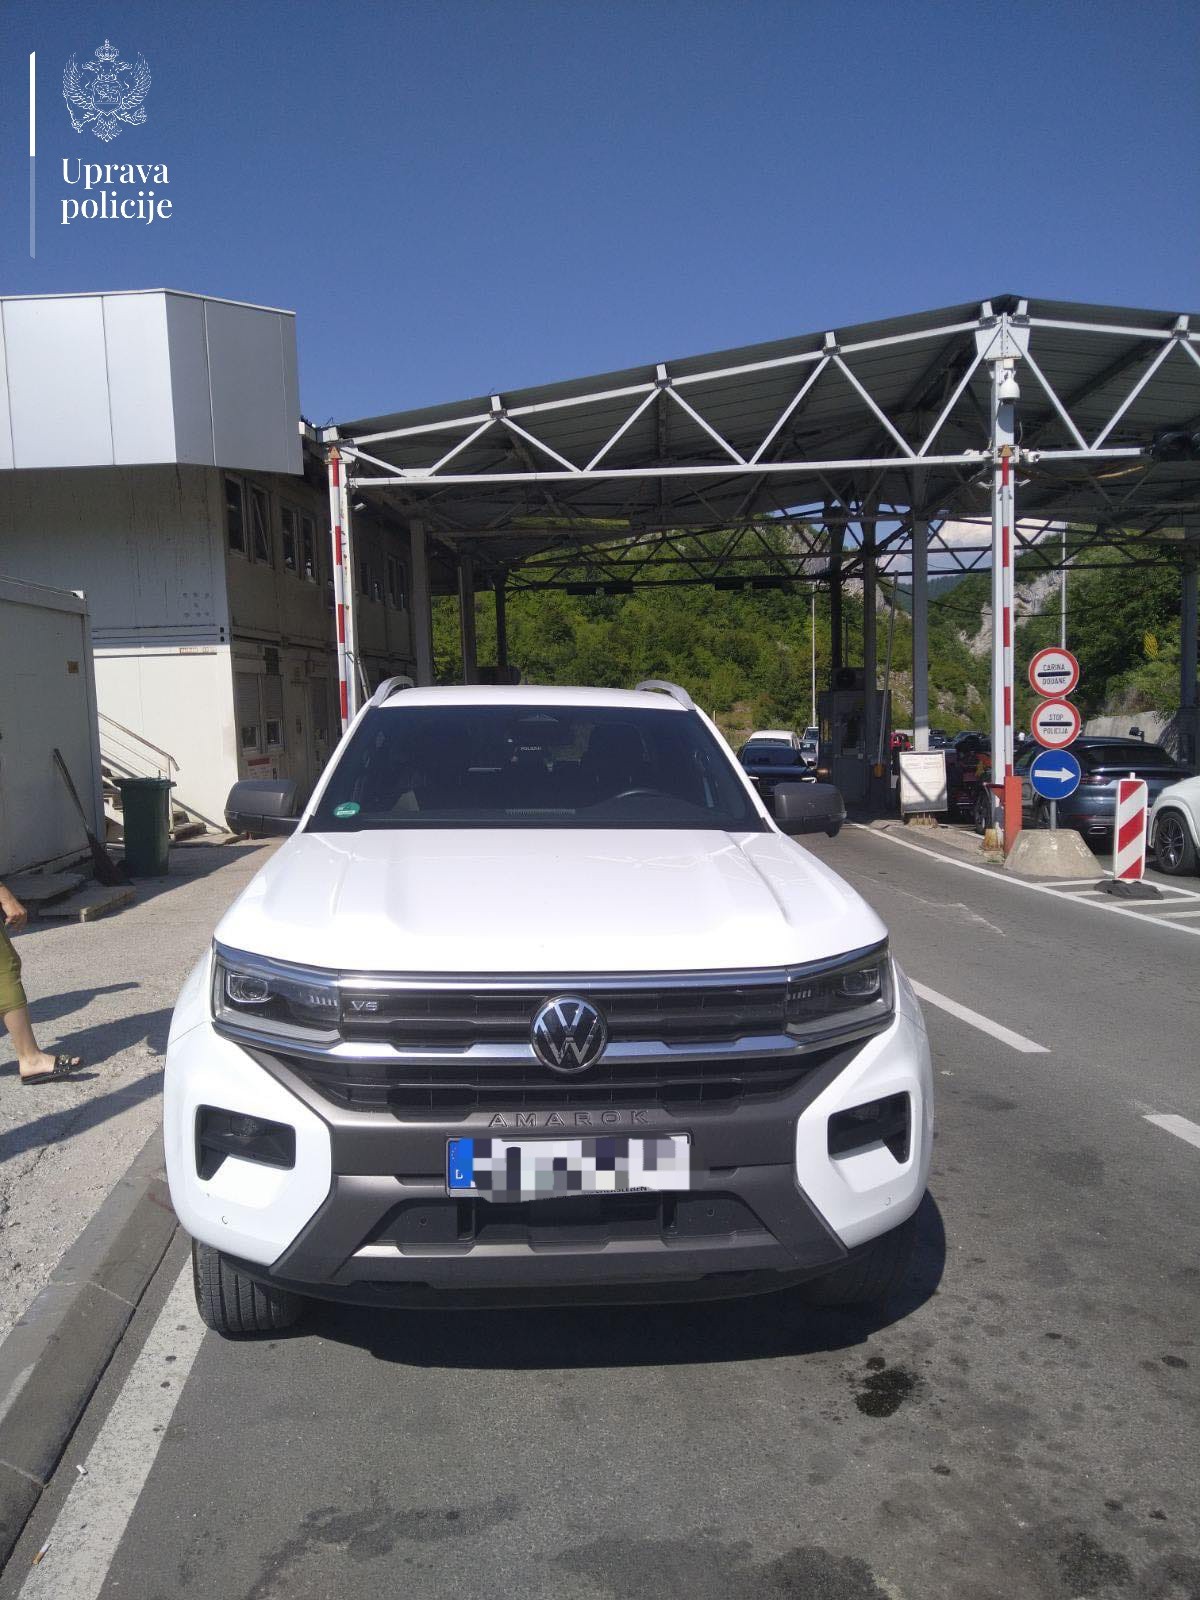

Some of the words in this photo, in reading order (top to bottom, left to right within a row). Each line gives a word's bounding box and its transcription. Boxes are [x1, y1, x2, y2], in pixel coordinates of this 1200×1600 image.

[1043, 663, 1066, 671] CARINA
[1049, 713, 1064, 721] STOP
[1043, 727, 1069, 735] POLICIJA
[351, 1000, 378, 1011] V6
[488, 1110, 649, 1128] AMAROK
